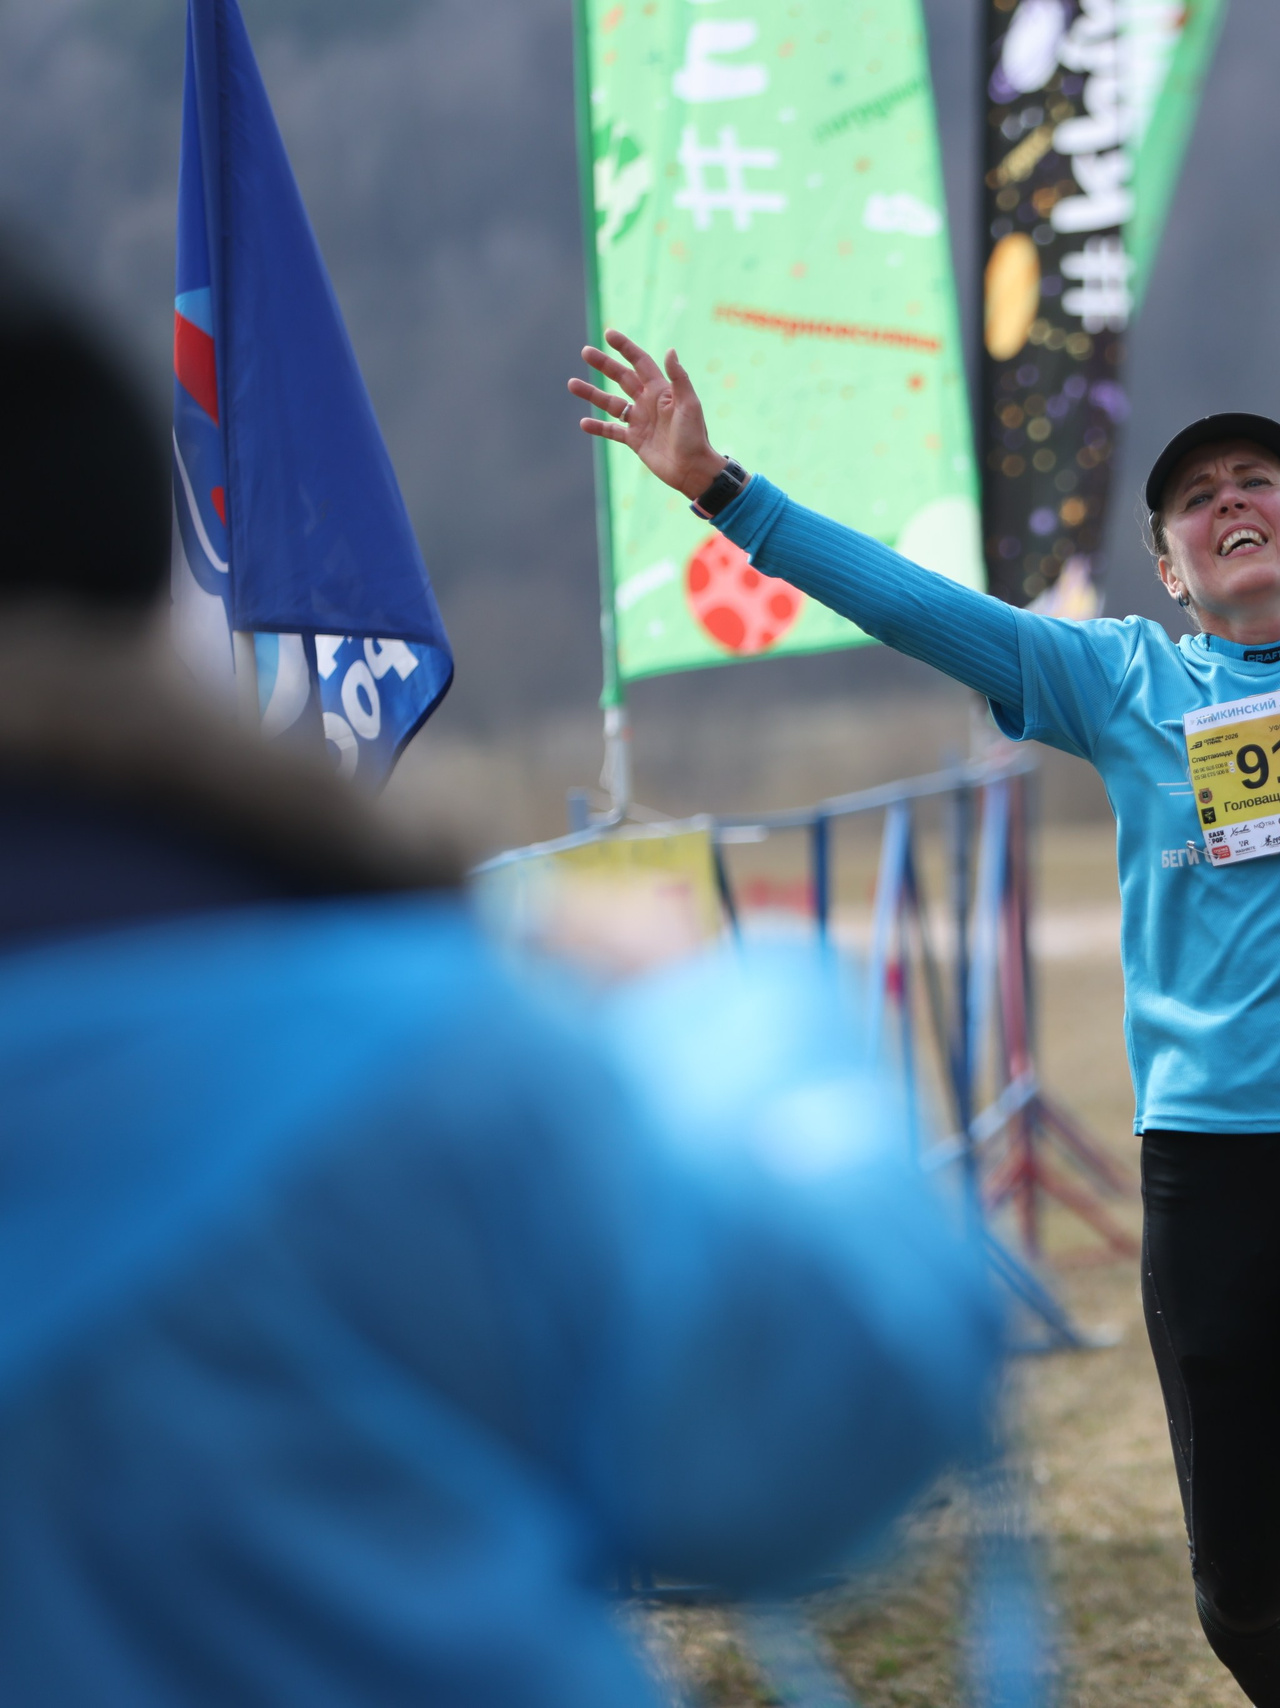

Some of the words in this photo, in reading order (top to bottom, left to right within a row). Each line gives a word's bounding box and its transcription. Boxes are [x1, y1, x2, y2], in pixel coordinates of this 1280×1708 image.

[1224, 732, 1239, 741] 2026
[1191, 749, 1234, 764] Спартакиада
[1161, 848, 1200, 869] БЕГИ
